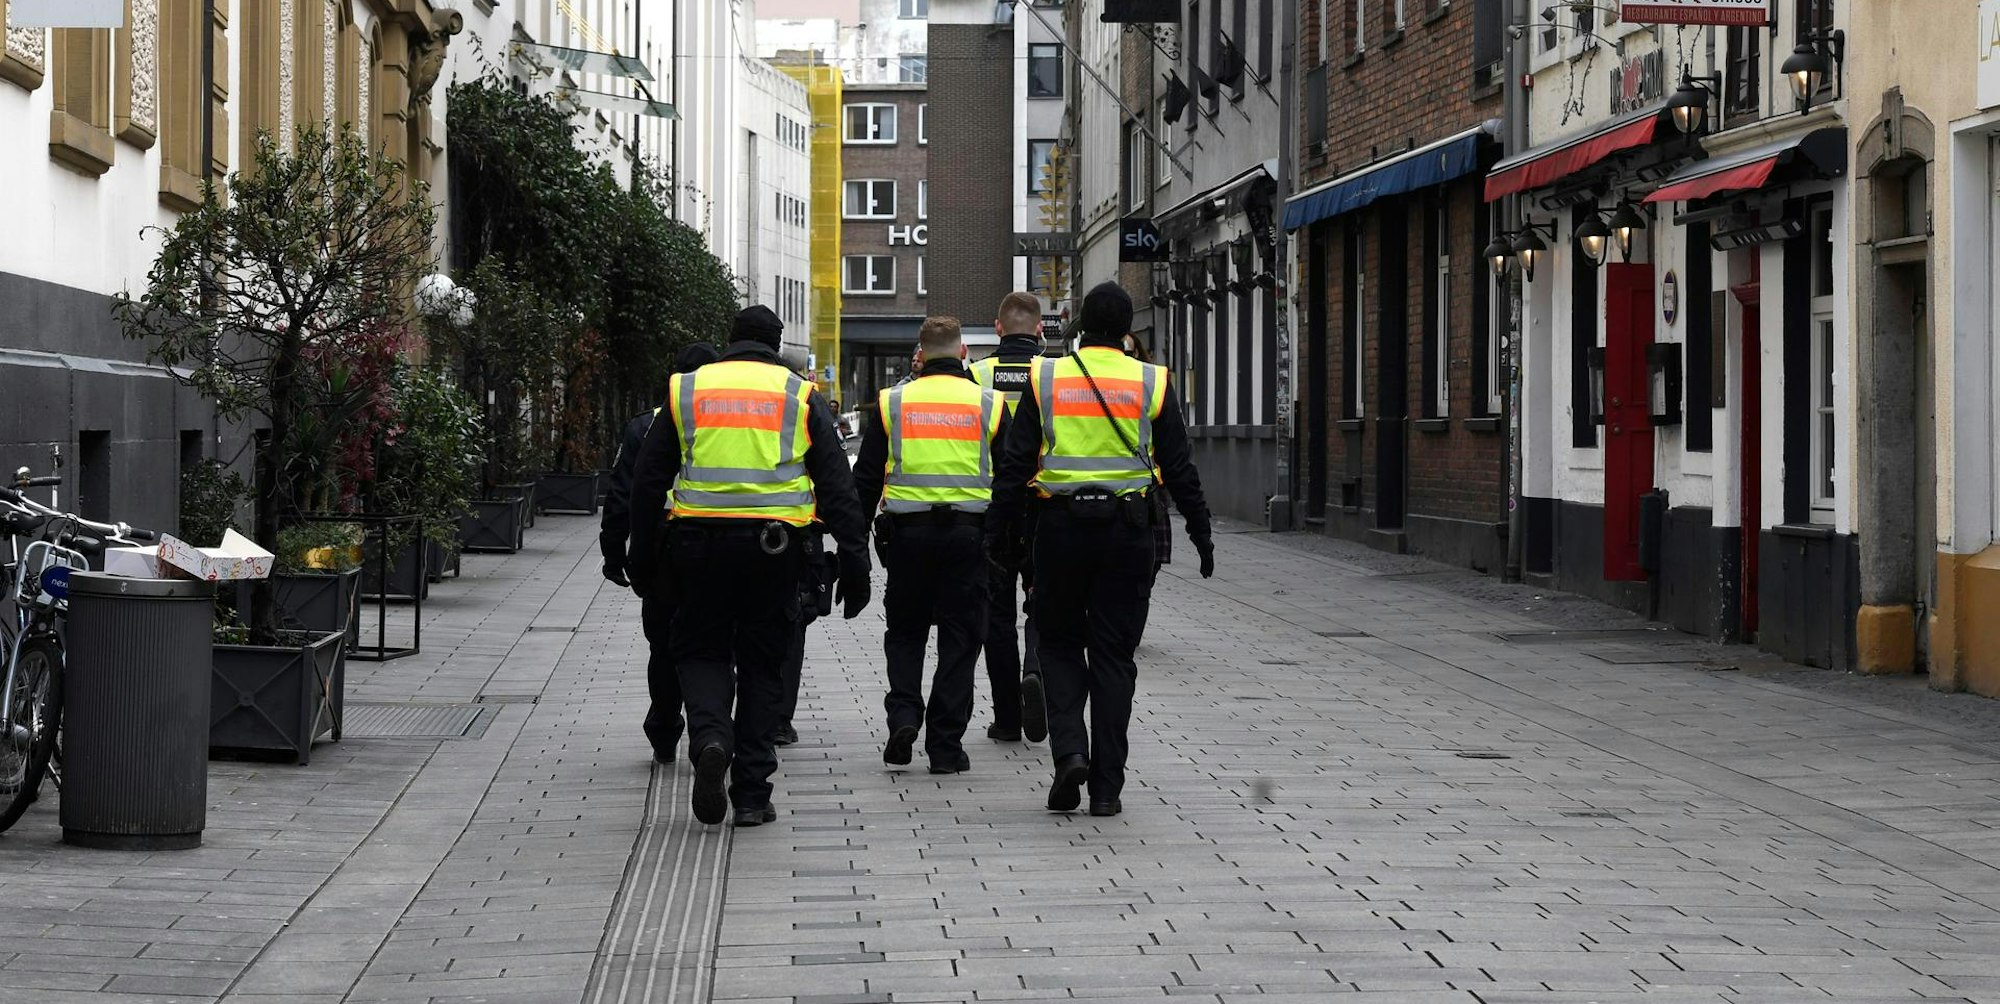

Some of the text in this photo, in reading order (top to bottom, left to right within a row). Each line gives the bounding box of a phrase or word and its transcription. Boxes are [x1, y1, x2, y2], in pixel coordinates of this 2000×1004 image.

[1626, 7, 1762, 22] RESTAURANTE ESPAÑOL Y ARGENTINO
[1125, 229, 1159, 252] sky
